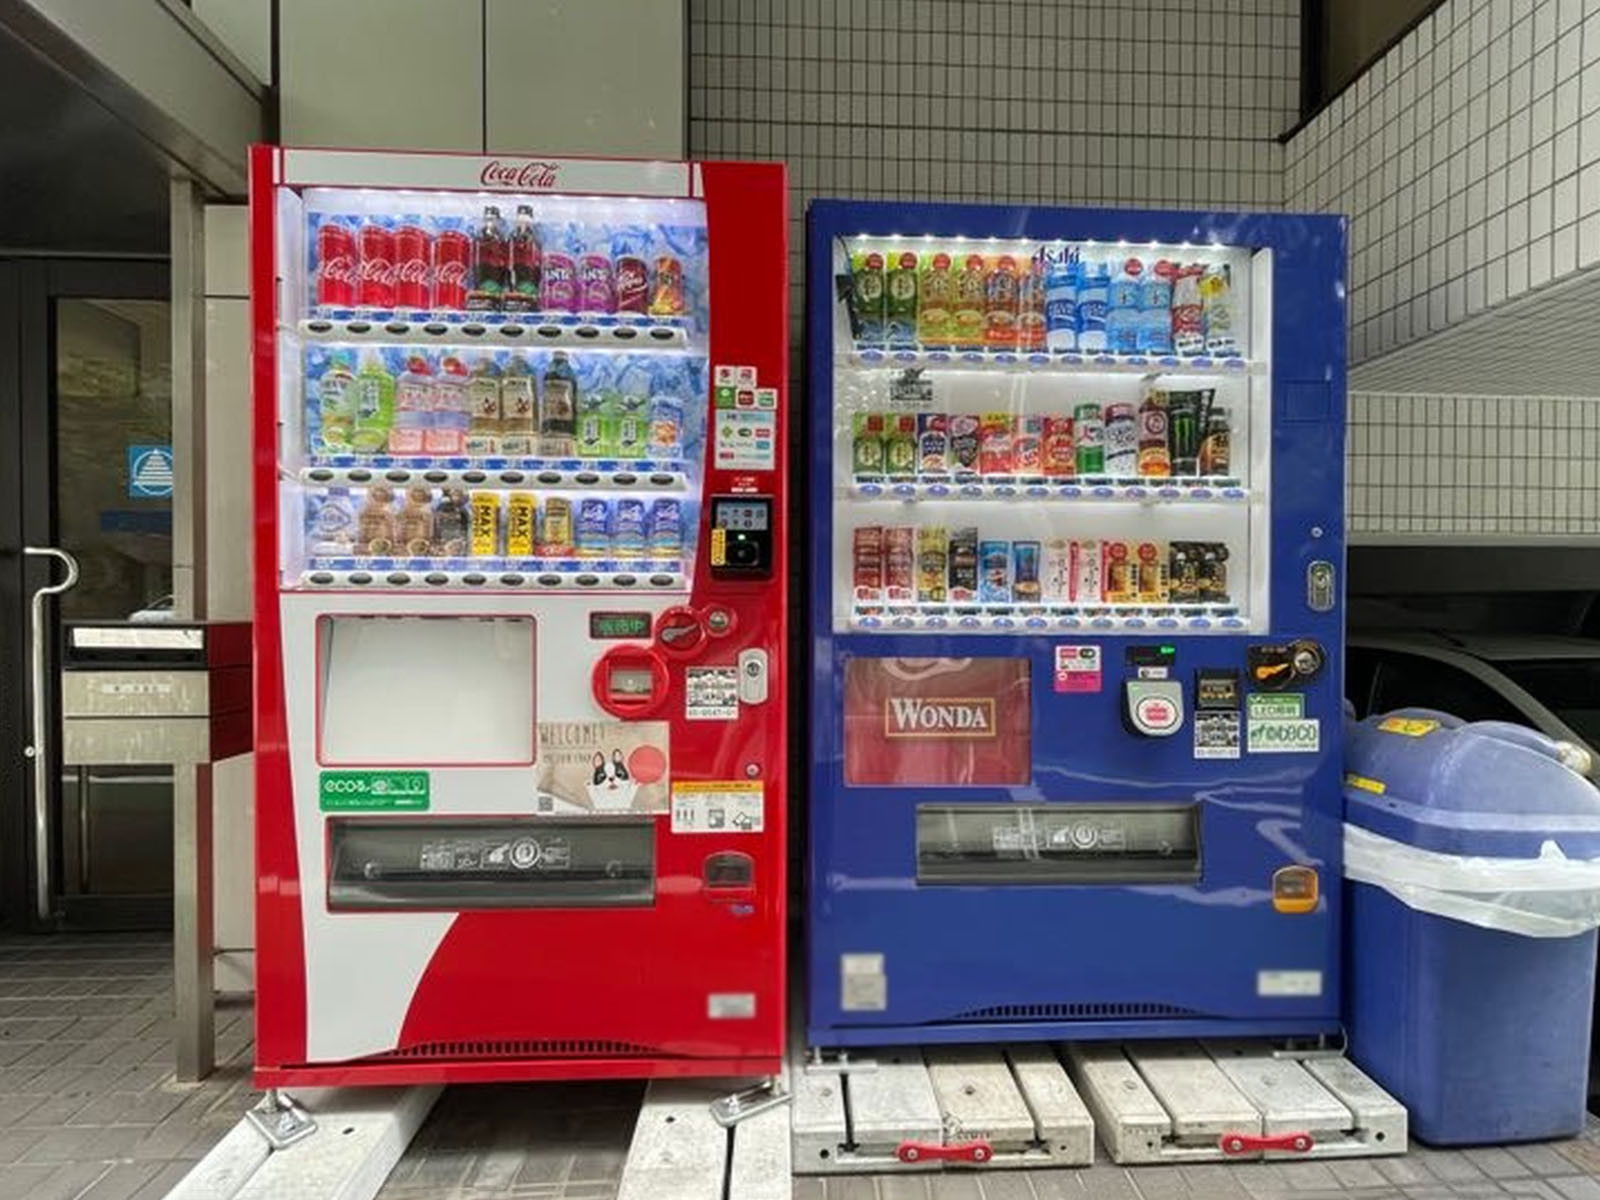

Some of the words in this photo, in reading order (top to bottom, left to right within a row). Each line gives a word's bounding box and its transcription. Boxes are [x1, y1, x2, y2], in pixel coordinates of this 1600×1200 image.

[1031, 245, 1080, 267] Asahi
[480, 504, 491, 538] MAX
[517, 505, 529, 538] MAX
[891, 697, 988, 730] WONDA
